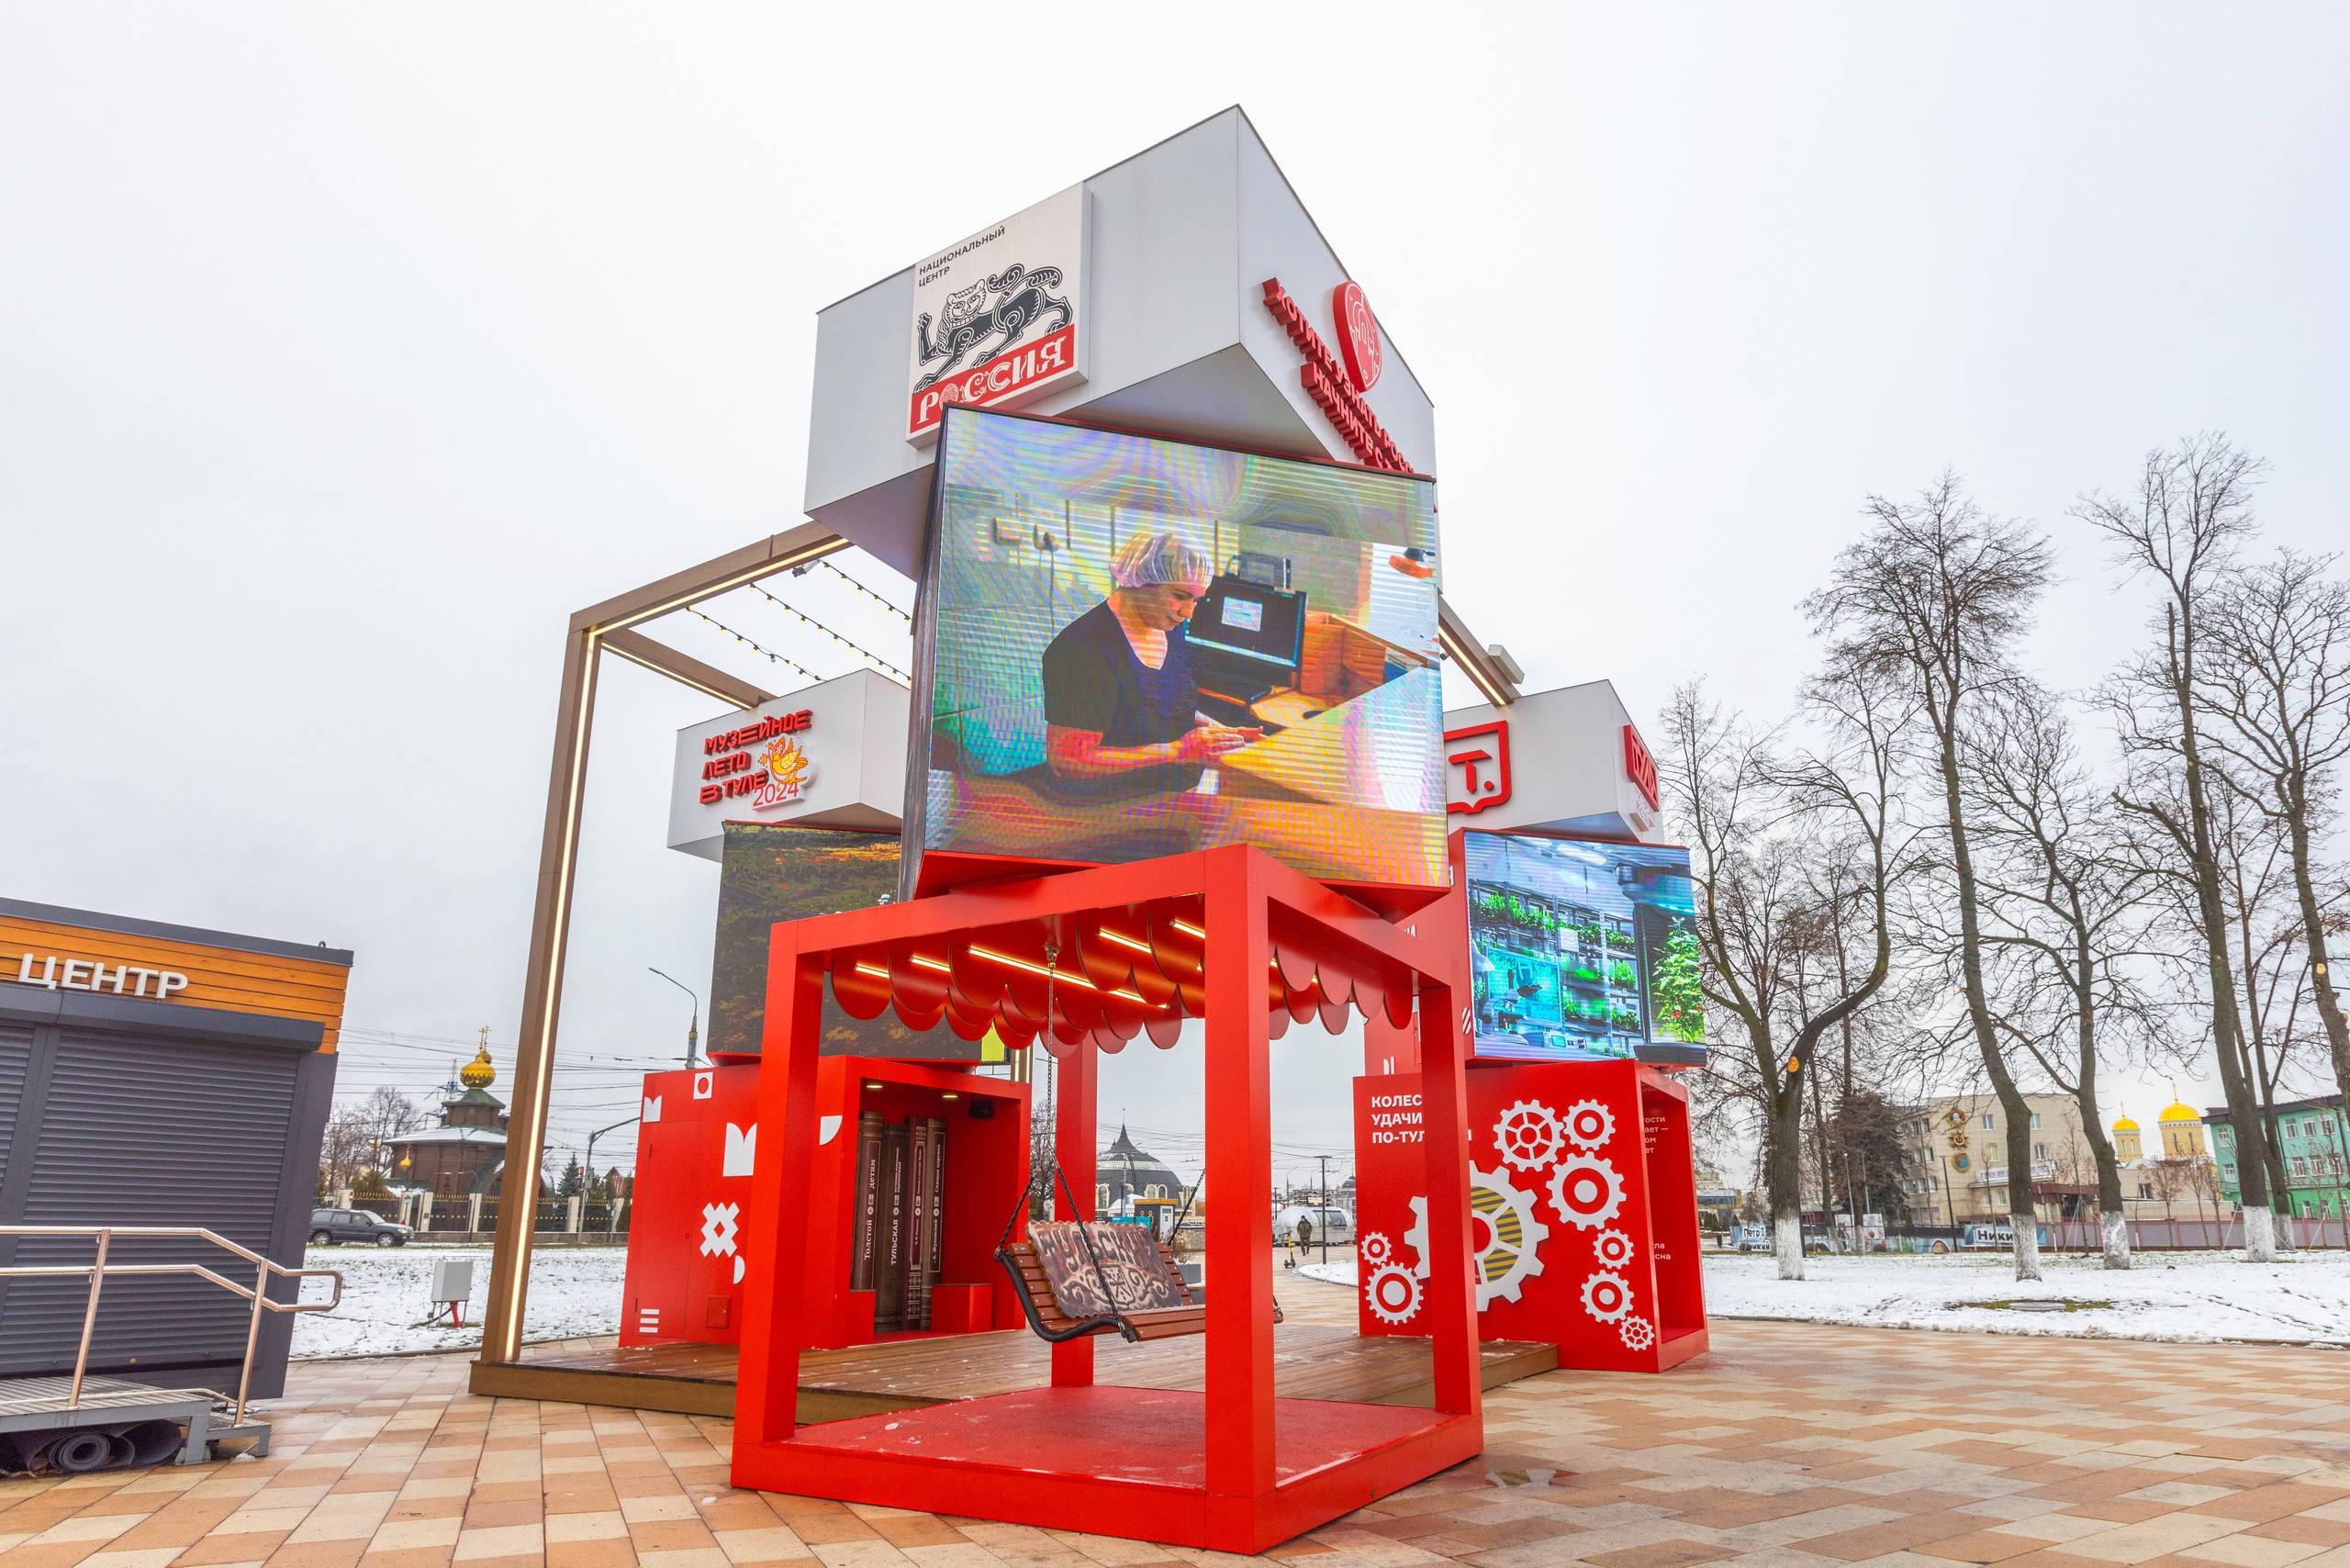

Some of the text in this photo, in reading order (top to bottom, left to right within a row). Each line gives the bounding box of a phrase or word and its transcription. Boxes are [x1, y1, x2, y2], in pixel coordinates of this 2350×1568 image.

[919, 225, 1005, 275] НАЦИОНАЛЬНЫЙ
[919, 266, 950, 287] ЦЕНТР
[917, 336, 1067, 424] РОССИЯ
[1262, 277, 1415, 473] ХОТИТЕ УЗНАТЬ РОСС
[1301, 361, 1374, 459] НАЧНИТЕ
[704, 710, 812, 756] МУЗЕЙНОЕ
[701, 751, 751, 780] ЛЕТО
[699, 769, 769, 805] В ТУЛЕ
[753, 782, 800, 806] 2024
[18, 953, 189, 1000] ЦЕНТР
[1371, 1094, 1423, 1108] КОЛЕС
[1371, 1113, 1423, 1128] УДАЧИ
[864, 1219, 873, 1260] Толстой
[890, 1219, 899, 1266] ТУЛЬСКАЯ
[1977, 1230, 2013, 1242] Ники
